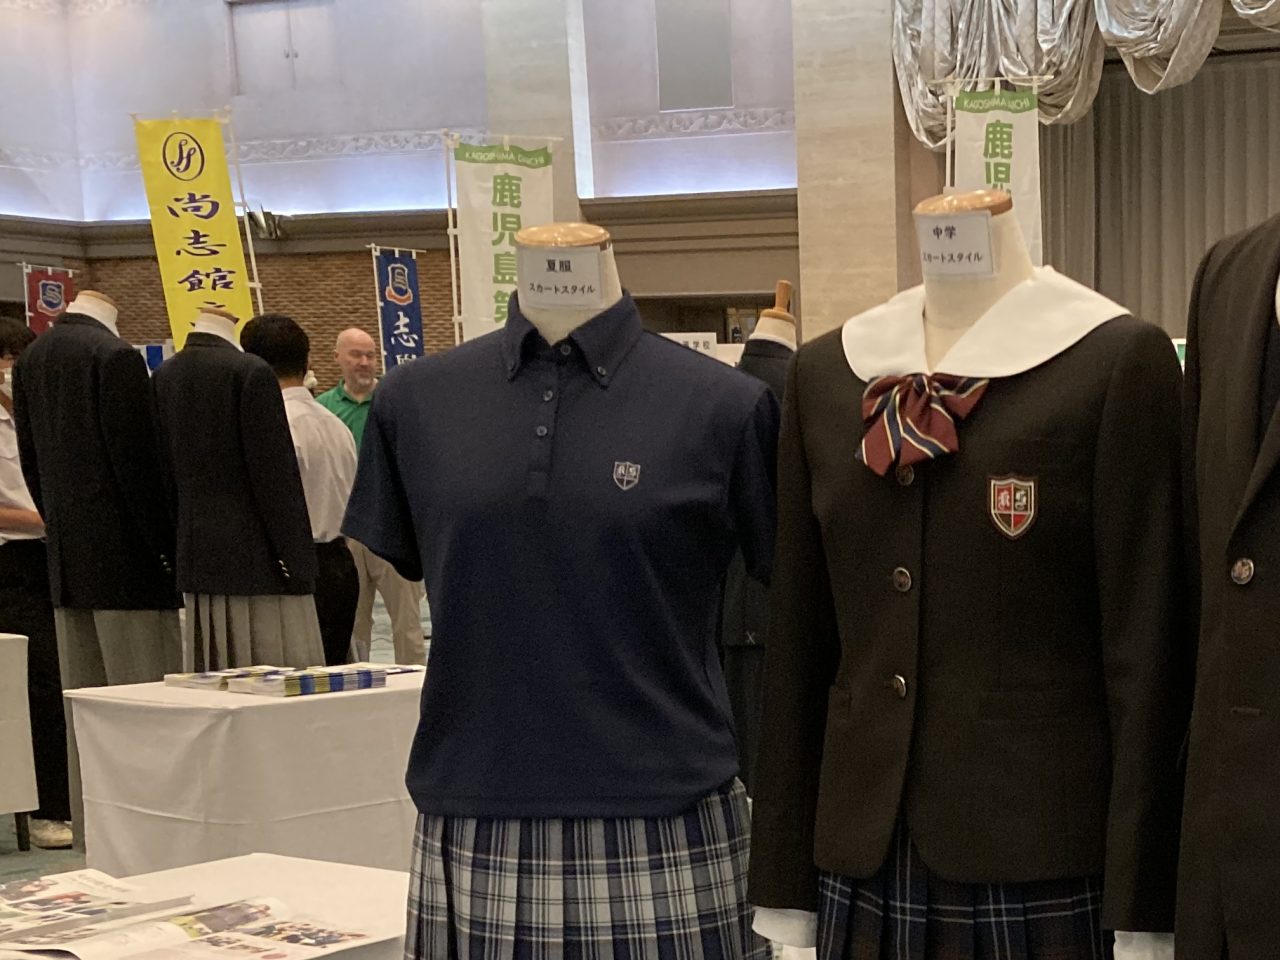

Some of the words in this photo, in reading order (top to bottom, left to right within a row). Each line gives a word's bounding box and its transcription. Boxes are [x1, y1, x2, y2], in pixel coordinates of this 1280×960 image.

[933, 225, 957, 240] 中学
[166, 192, 238, 309] 尚志館
[546, 259, 573, 274] 夏服
[529, 282, 596, 295] スカートスタイル
